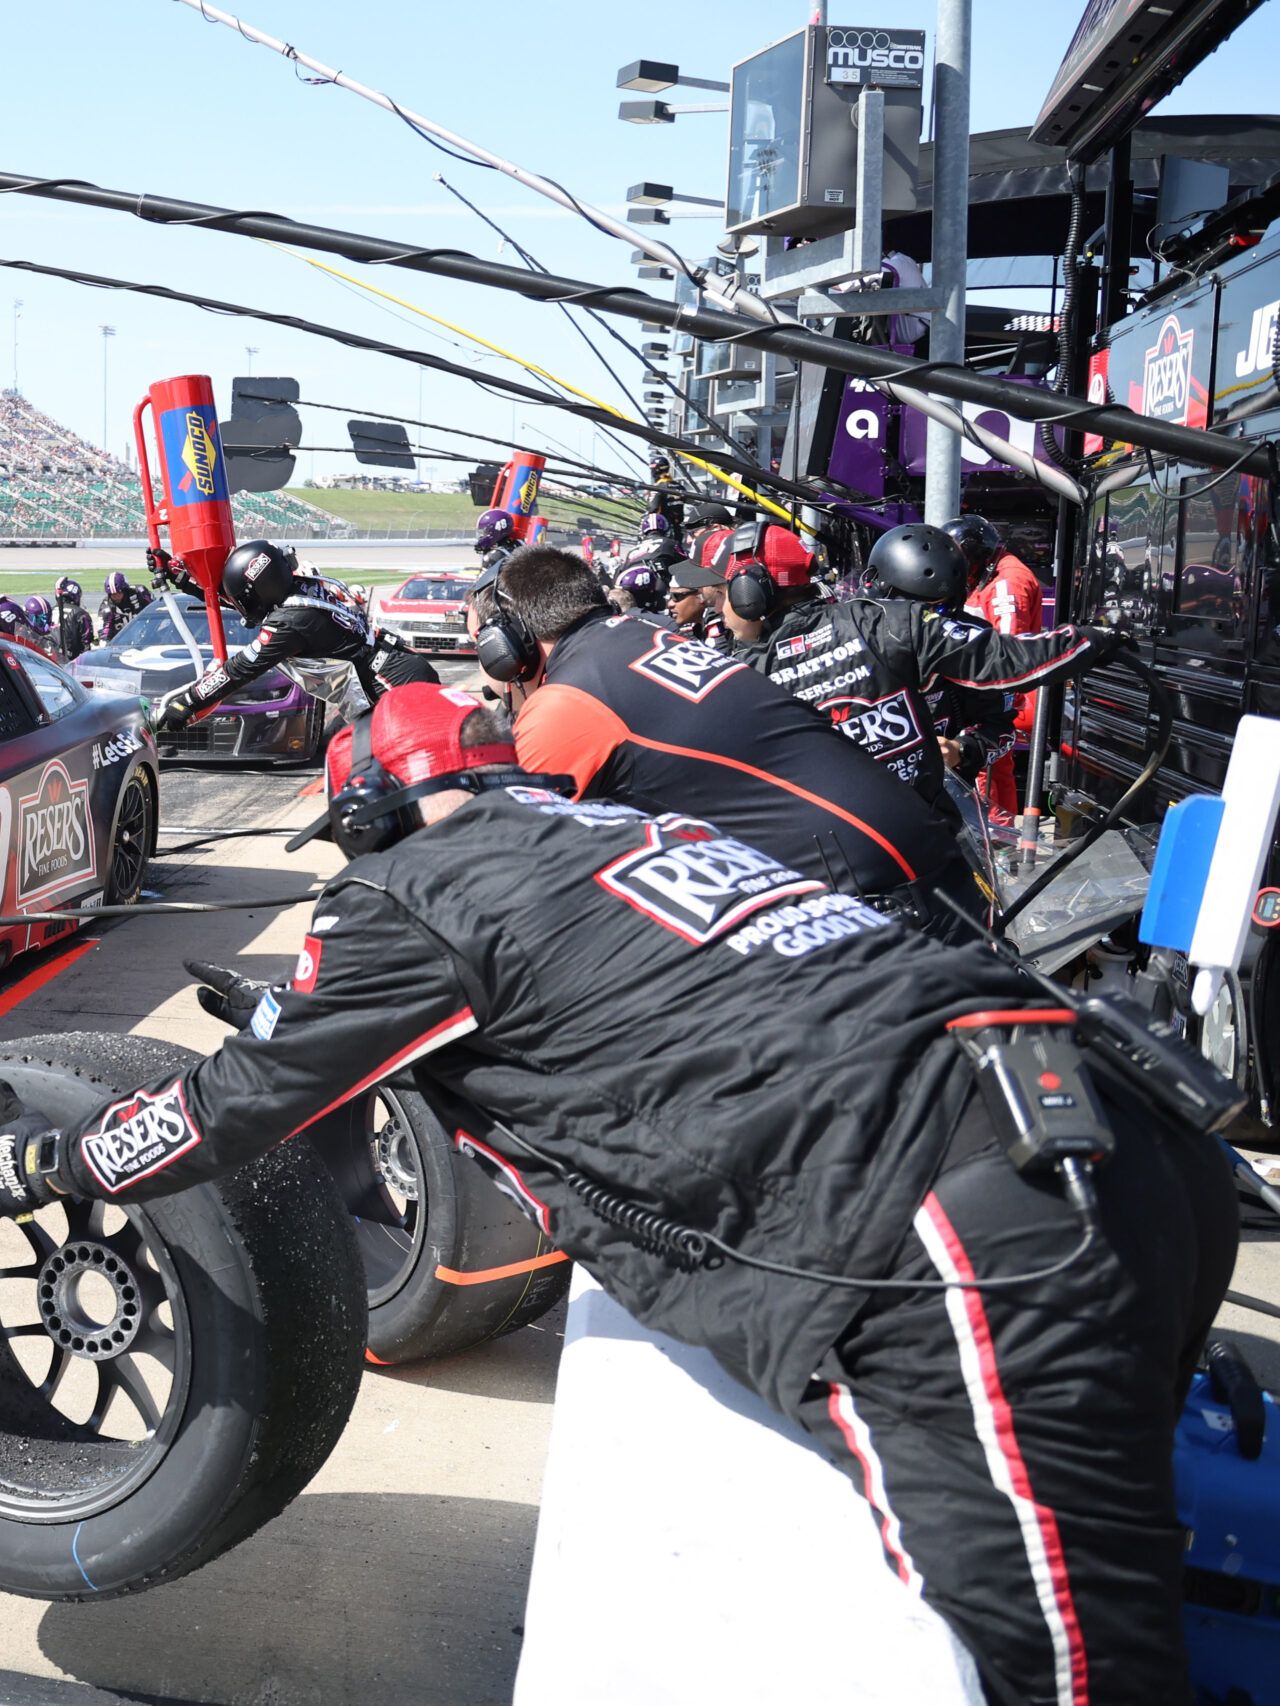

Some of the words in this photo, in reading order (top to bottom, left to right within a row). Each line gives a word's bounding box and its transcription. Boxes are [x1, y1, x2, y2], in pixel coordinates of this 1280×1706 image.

[186, 412, 214, 496] SUNOCO
[521, 471, 537, 513] SUNOCO
[494, 518, 508, 531] 48
[66, 583, 78, 595] 48
[633, 571, 650, 587] 48
[0, 610, 17, 623] 48
[770, 638, 863, 685] BRATTON
[792, 665, 871, 701] SERS.COM
[23, 795, 86, 887] RESER'S
[38, 862, 52, 878] FINE
[51, 855, 68, 875] FOODS
[726, 904, 807, 955] PROUD
[773, 910, 862, 957] GOOD
[123, 1158, 141, 1174] FINE
[140, 1143, 166, 1166] FOODS
